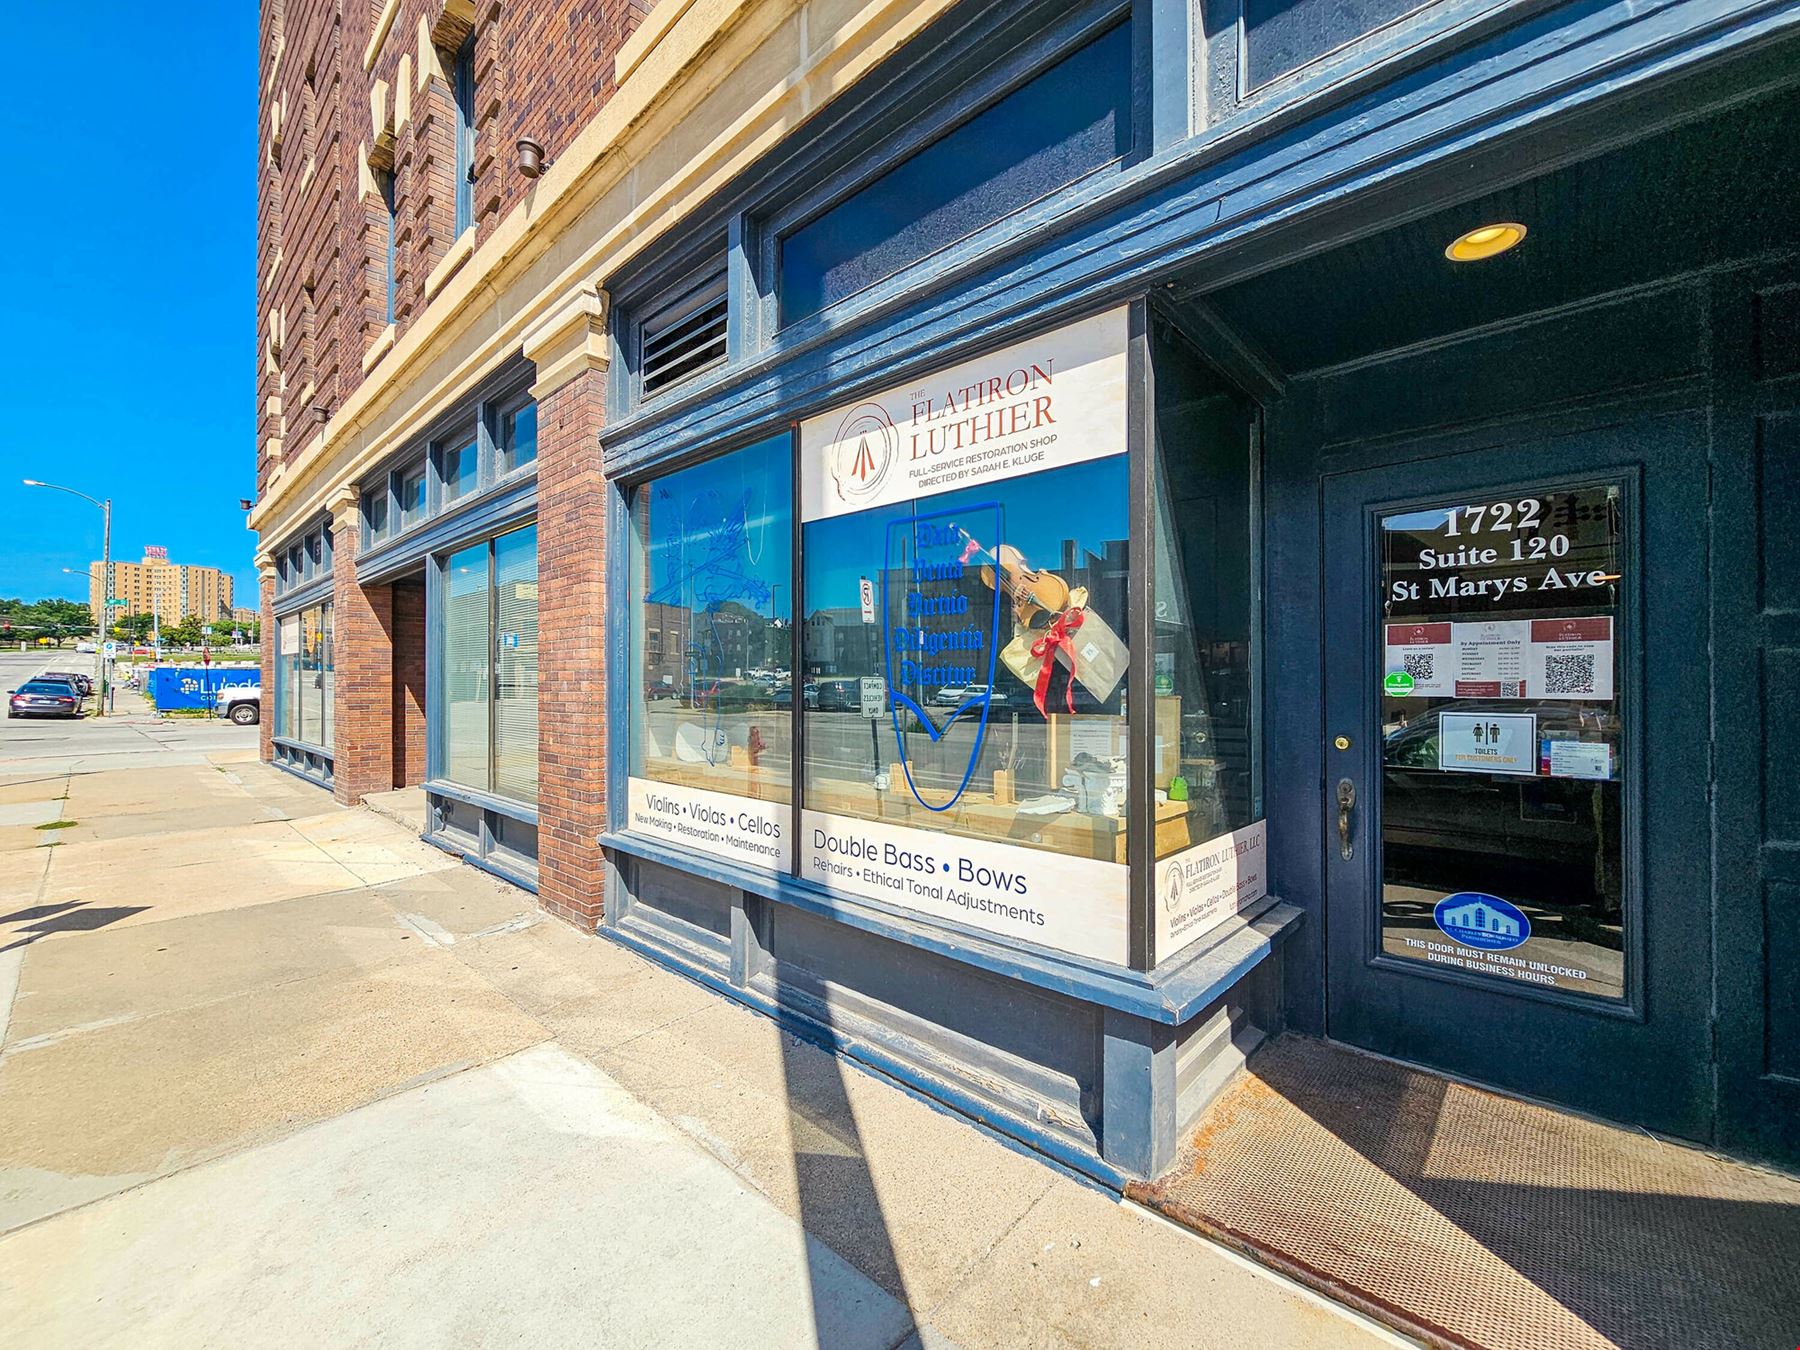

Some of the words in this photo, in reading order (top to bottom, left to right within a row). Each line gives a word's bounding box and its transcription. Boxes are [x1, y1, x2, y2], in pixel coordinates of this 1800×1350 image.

[909, 388, 926, 401] THE
[911, 357, 1055, 427] FLATIRON
[909, 394, 1057, 461] LUTHIER
[909, 457, 964, 478] FULL-SERVICE
[966, 441, 1028, 464] RESTORATION
[1029, 433, 1058, 449] SHOP
[918, 474, 957, 488] DIRECTED
[958, 469, 970, 479] BY
[971, 461, 1001, 476] SARAH
[1003, 459, 1011, 469] E.
[1012, 450, 1045, 467] KLUGE
[1443, 498, 1541, 538] 1722
[1419, 544, 1498, 570] Suite
[1510, 534, 1570, 561] 120
[1392, 580, 1421, 602] St
[1429, 573, 1528, 602] Marys
[1538, 567, 1607, 591] Ave
[635, 812, 648, 824] New
[649, 816, 673, 833] Making
[677, 823, 719, 843] Restoration
[726, 834, 781, 858] Maintenance
[645, 793, 680, 816] Violins
[689, 802, 726, 826] Violas
[738, 812, 781, 839] Cellos
[814, 828, 878, 862] Double
[884, 842, 935, 875] Bass
[958, 857, 1028, 895] Bows
[1185, 851, 1221, 879] FLATIRON
[1249, 834, 1260, 849] LLC
[813, 856, 853, 878] Rehairs
[863, 868, 904, 890] Ethical
[906, 878, 943, 900] Tonal
[946, 888, 1045, 926] Adjustments
[1404, 937, 1426, 950] THIS
[1427, 941, 1454, 955] DOOR
[1456, 946, 1485, 960] MUST
[1487, 952, 1526, 968] REMAIN
[1529, 960, 1587, 980] UNLOCKED
[1427, 952, 1464, 967] DURING
[1466, 959, 1515, 978] BUSINESS
[1518, 969, 1558, 986] HOURS.
